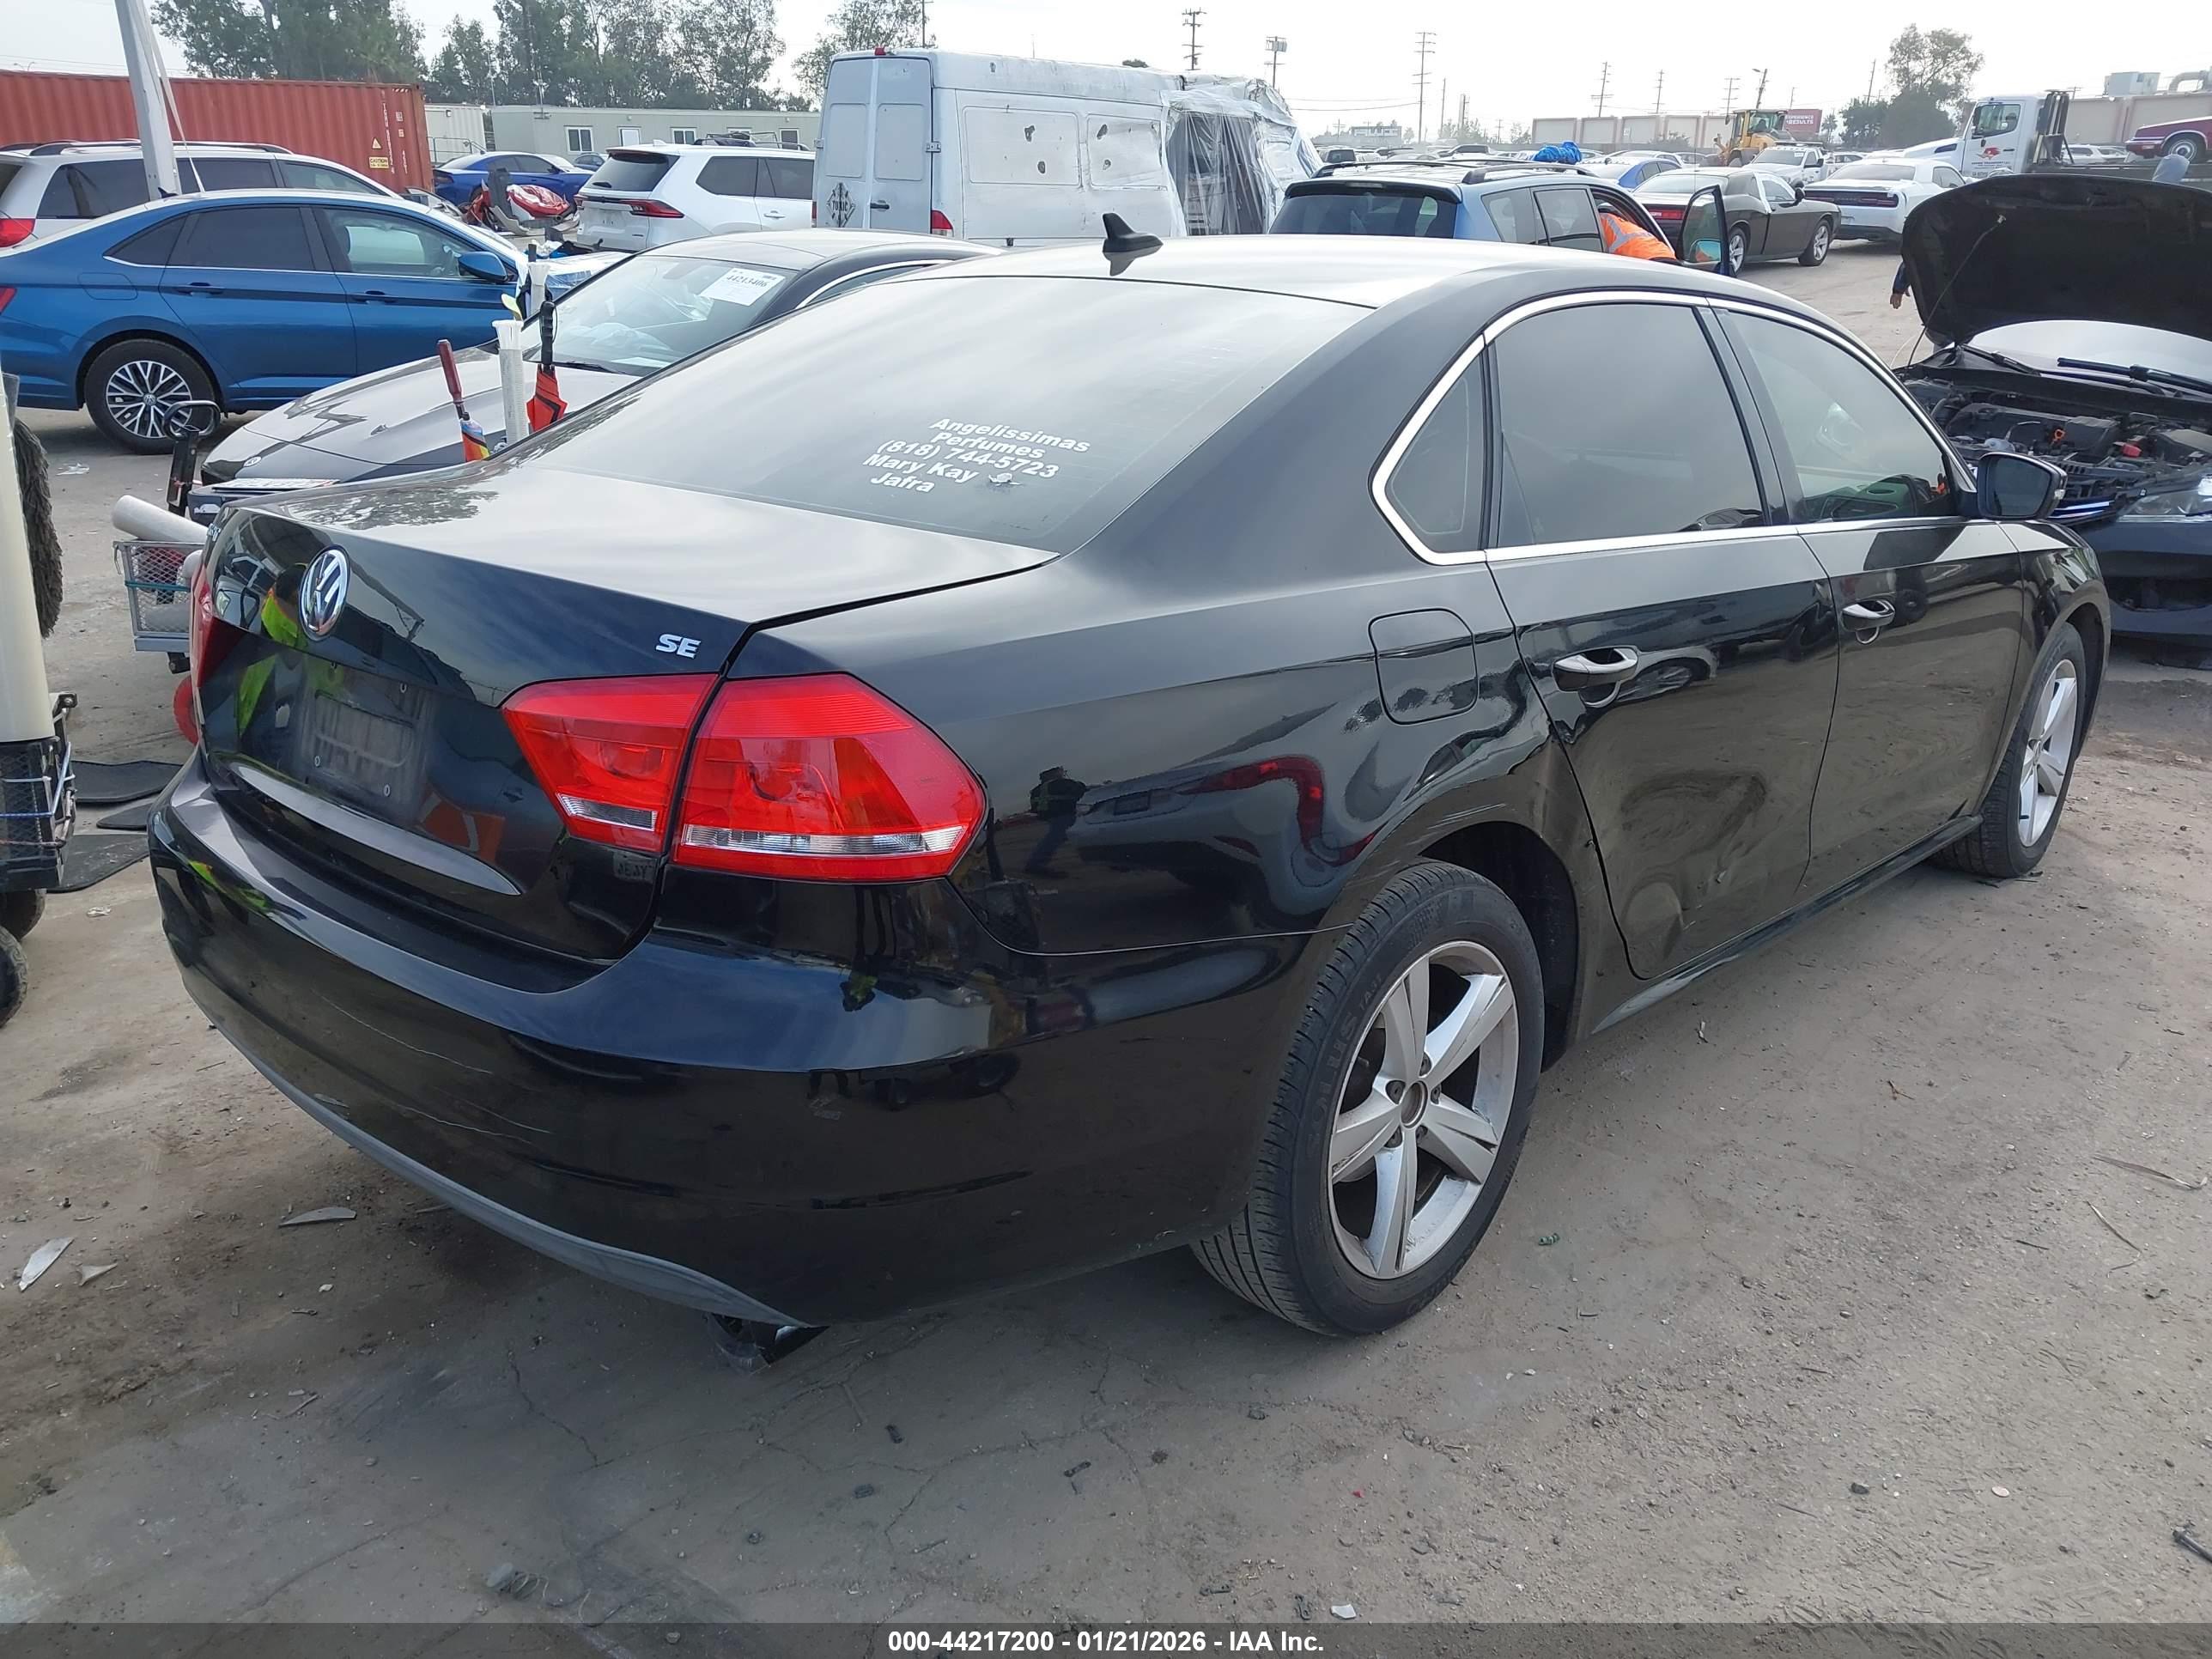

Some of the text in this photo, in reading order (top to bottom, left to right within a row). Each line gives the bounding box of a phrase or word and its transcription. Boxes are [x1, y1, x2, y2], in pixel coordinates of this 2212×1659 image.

[832, 201, 848, 211] TOXIC
[726, 275, 769, 288] 44213406
[929, 418, 1091, 453] Angelissimas
[931, 432, 1046, 459] Perfumes
[863, 453, 980, 484] Mary Kay
[876, 439, 1060, 479] (818) 744-5723
[870, 471, 934, 493] Jafra
[655, 633, 702, 659] SE
